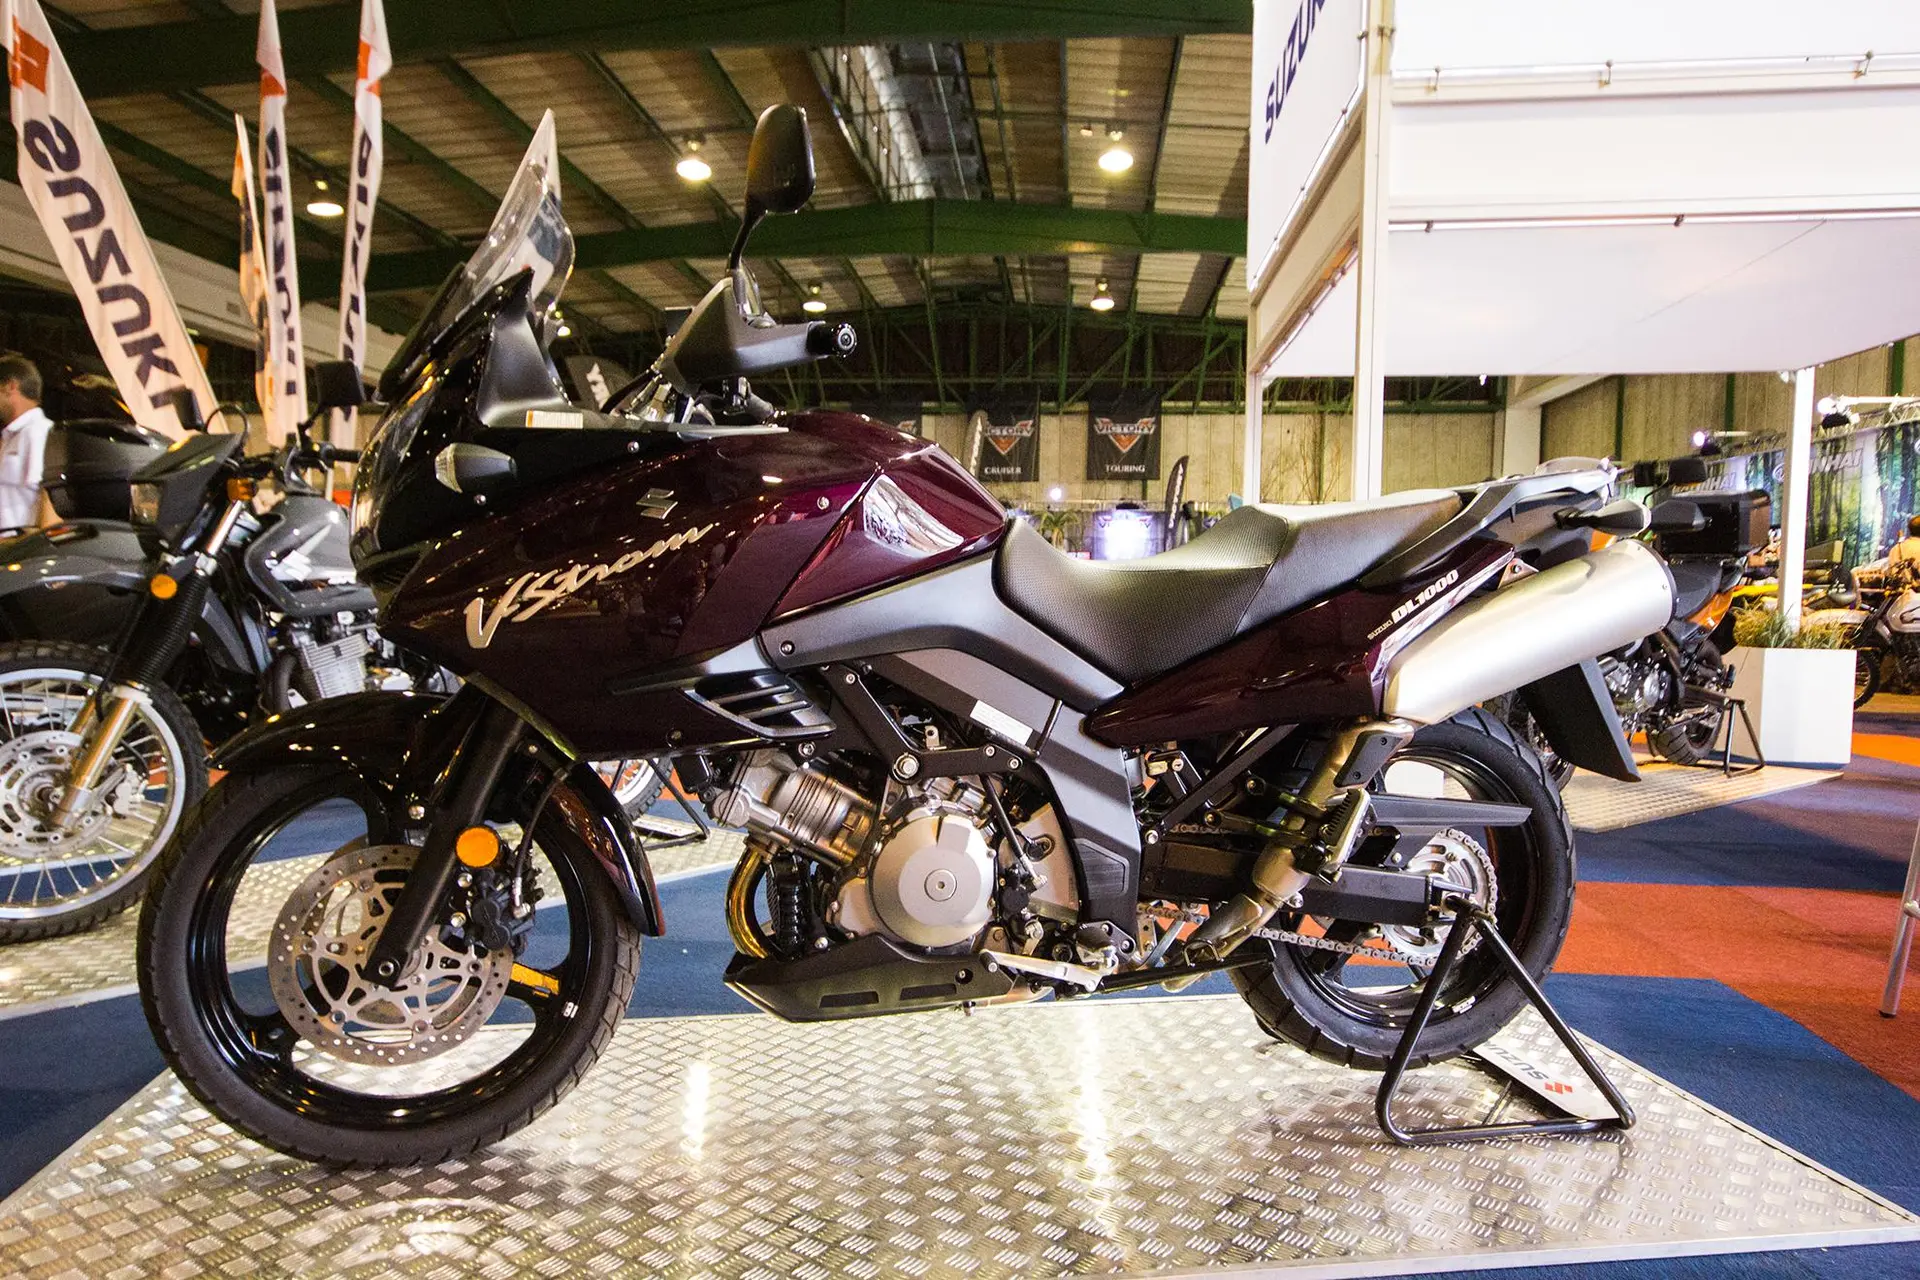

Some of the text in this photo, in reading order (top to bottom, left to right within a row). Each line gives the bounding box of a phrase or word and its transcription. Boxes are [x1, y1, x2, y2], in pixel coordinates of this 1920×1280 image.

[1094, 418, 1156, 435] VICTORY
[1105, 464, 1146, 473] TOURING
[1808, 448, 1863, 474] NHAI
[1367, 569, 1459, 640] SUZUKI DL1000
